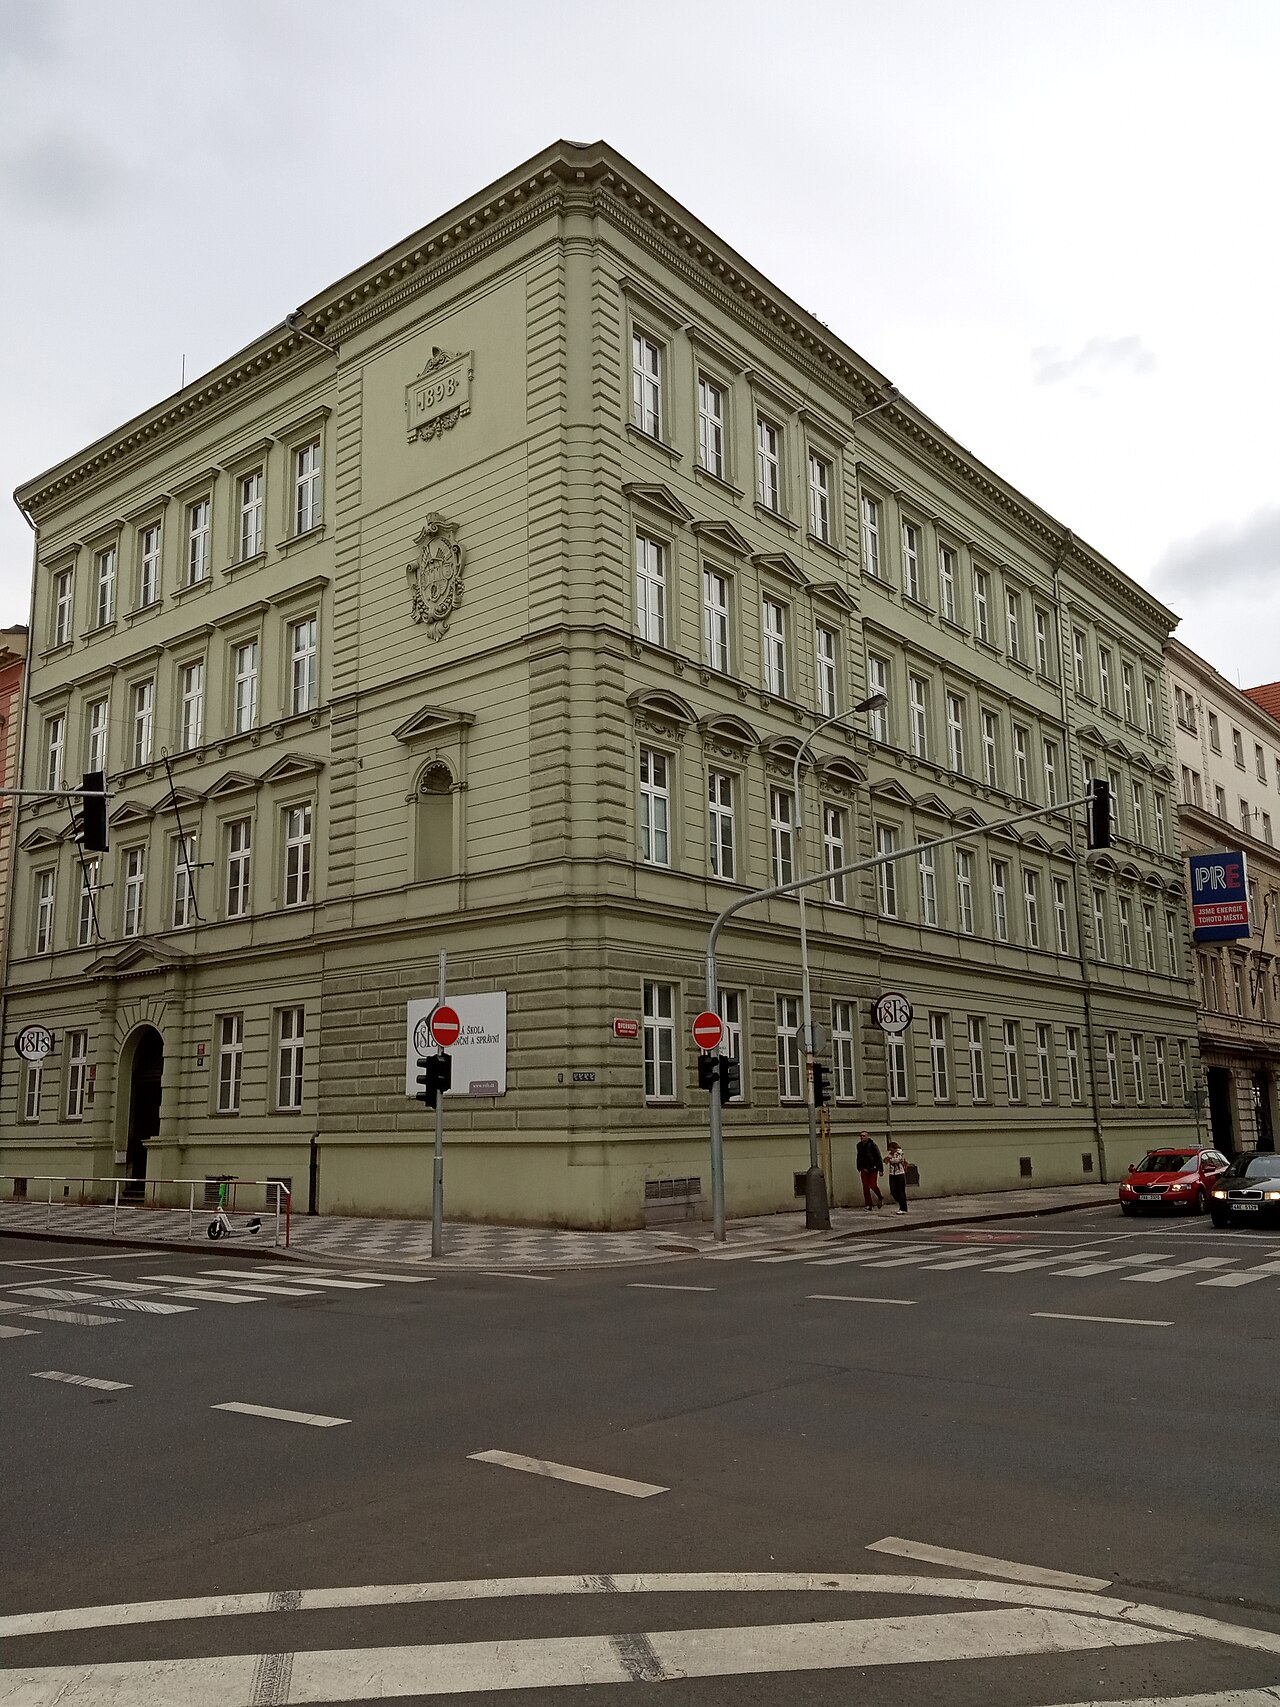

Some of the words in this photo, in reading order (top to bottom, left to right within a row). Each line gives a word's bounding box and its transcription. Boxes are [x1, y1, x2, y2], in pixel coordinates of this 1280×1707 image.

[420, 378, 456, 411] 1898
[1195, 864, 1240, 891] PRE
[1217, 905, 1243, 913] ENERGIE
[1198, 915, 1222, 923] TOHOTO
[1223, 913, 1244, 922] MĚSTA
[467, 1025, 485, 1035] ŠKOLA
[471, 1037, 475, 1045] A
[476, 1033, 499, 1045] SPRÁVNÍ
